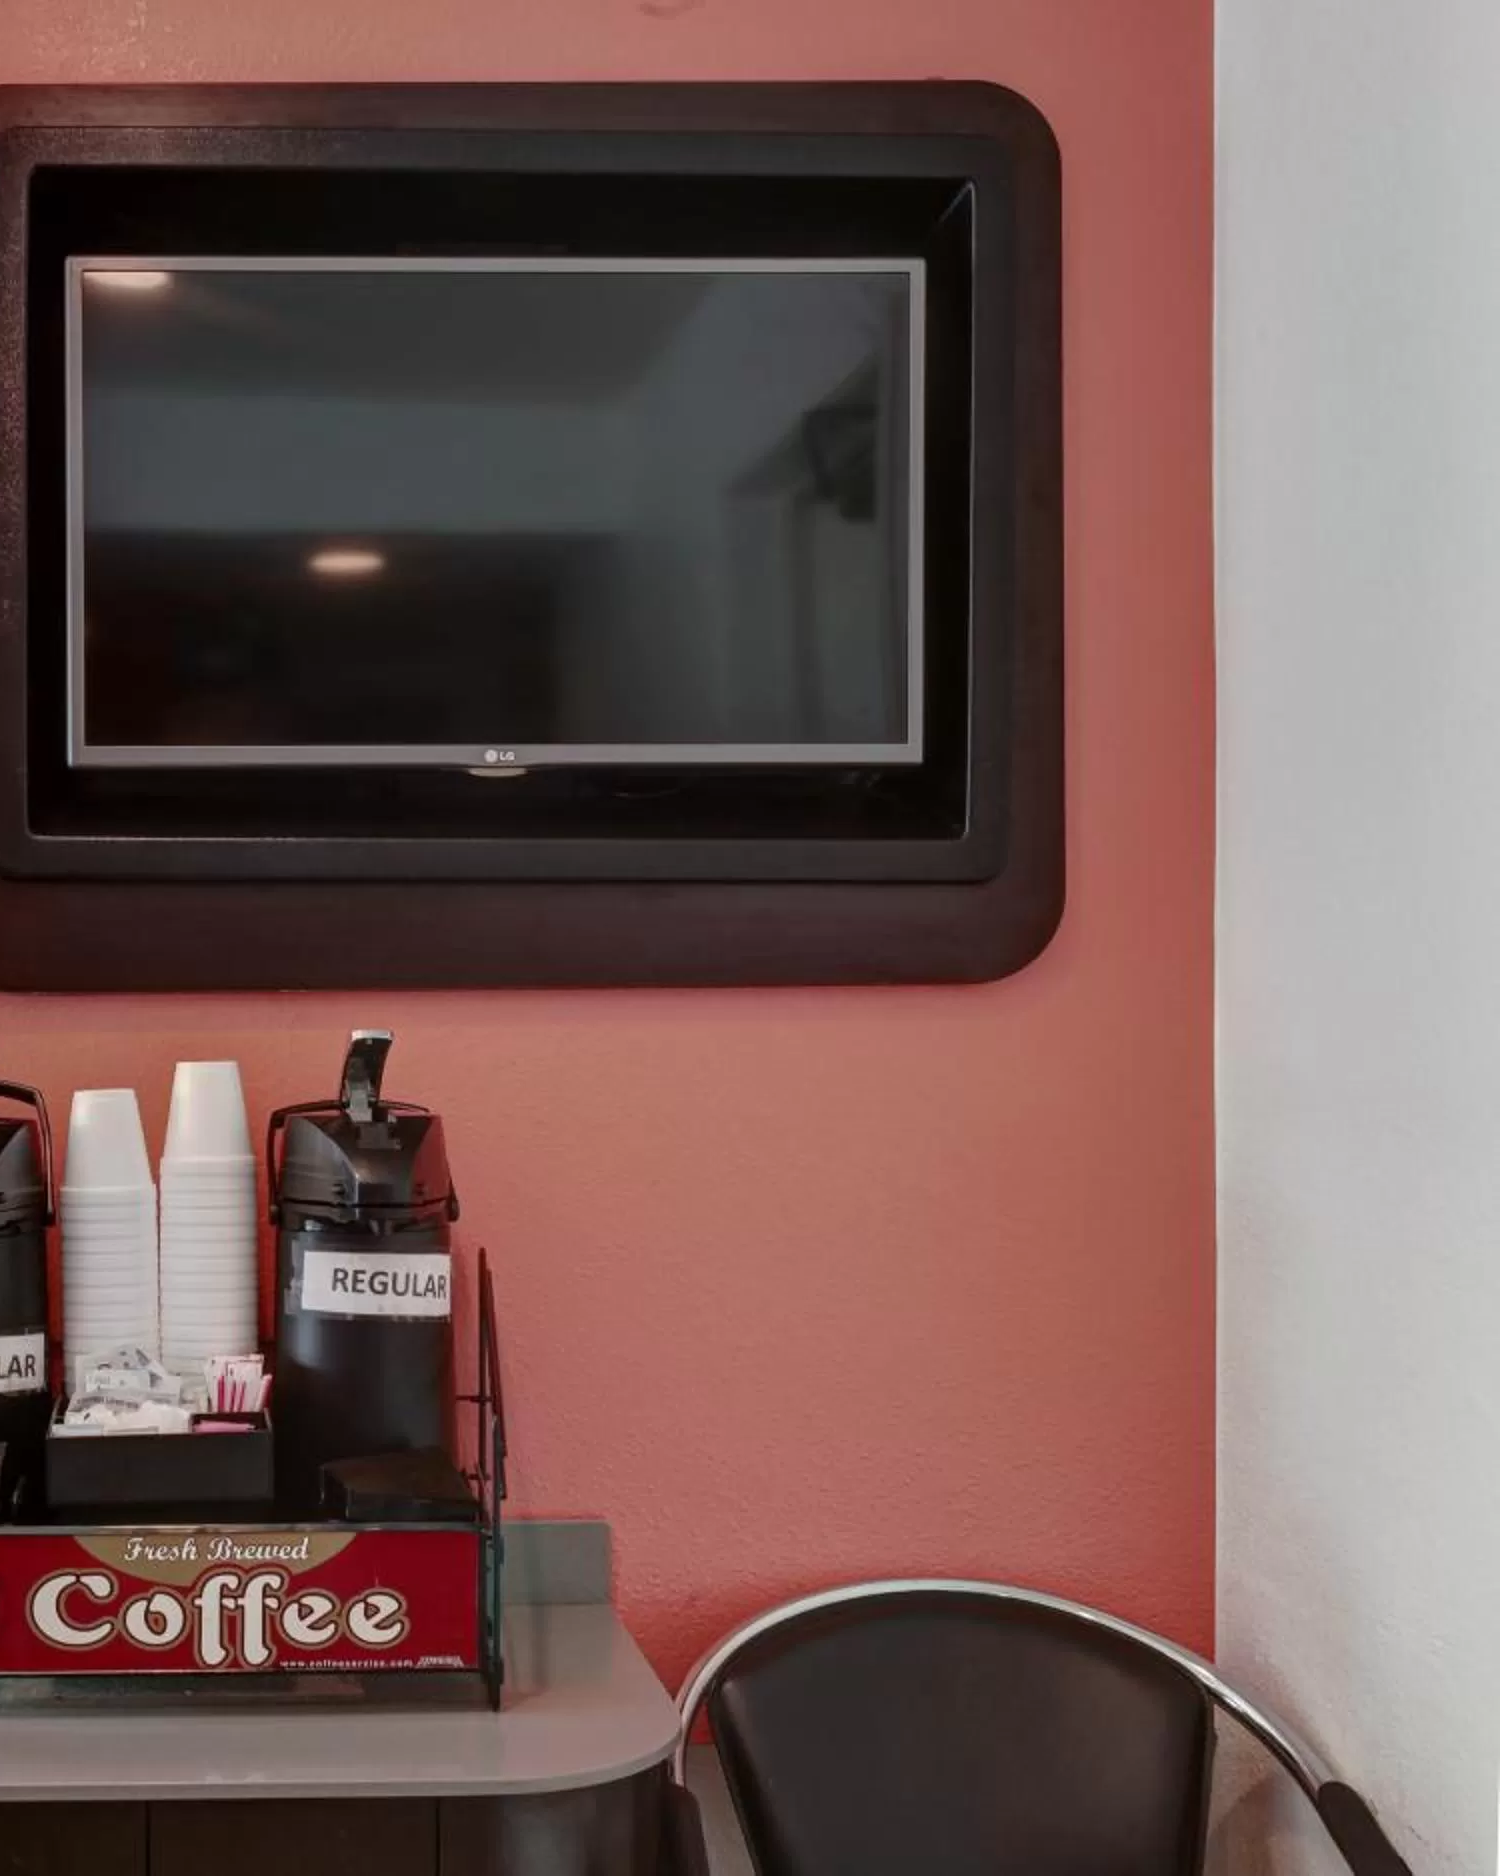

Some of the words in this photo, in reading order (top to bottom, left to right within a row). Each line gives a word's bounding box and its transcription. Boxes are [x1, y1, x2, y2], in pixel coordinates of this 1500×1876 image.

[499, 751, 516, 761] LG
[331, 1267, 448, 1300] REGULAR
[124, 1536, 198, 1561] Fresh
[207, 1535, 309, 1560] Brewed
[28, 1570, 407, 1667] Coffee
